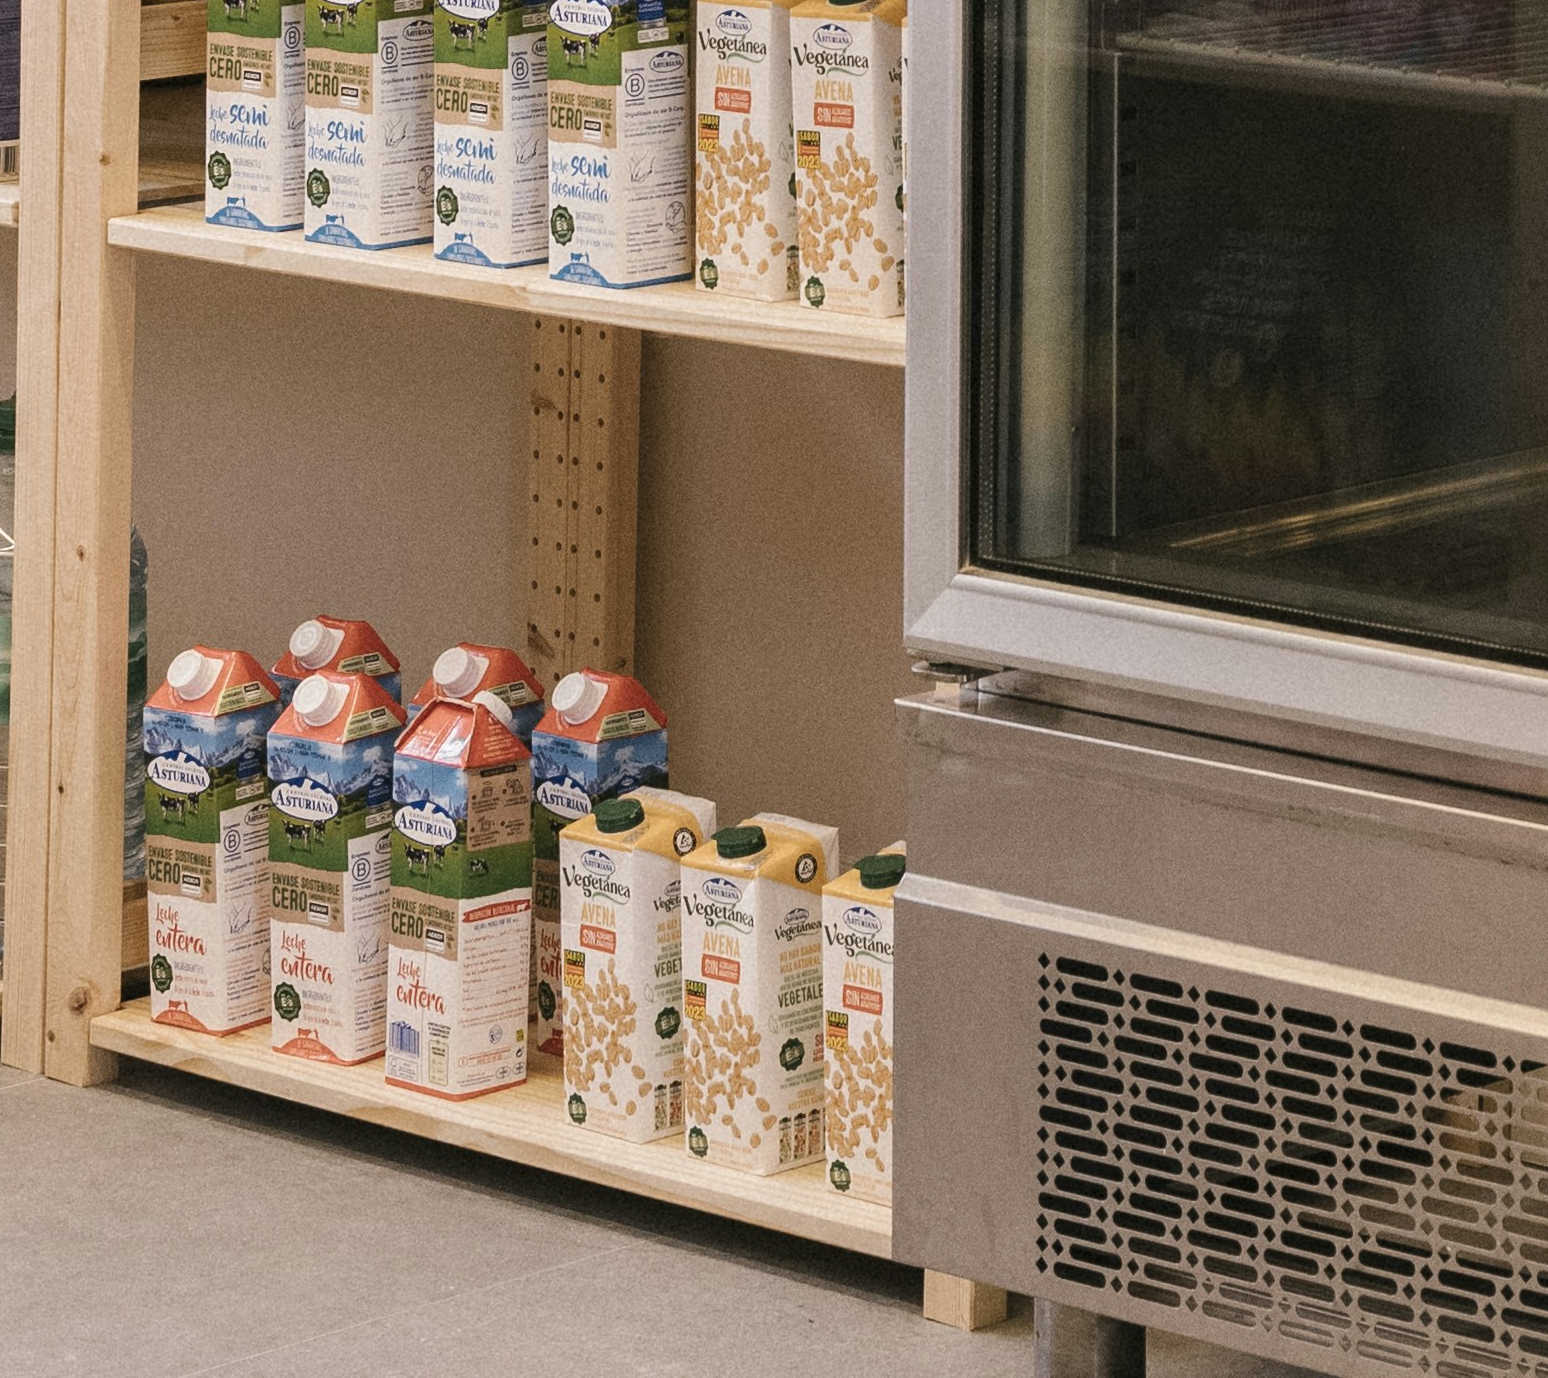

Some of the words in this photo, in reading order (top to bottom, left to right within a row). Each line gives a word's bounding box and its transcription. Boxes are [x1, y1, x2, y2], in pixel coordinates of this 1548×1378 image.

[553, 5, 608, 27] ASTURIANA
[717, 17, 752, 32] ASTURIANA
[698, 28, 767, 60] Vegetánea
[814, 31, 853, 45] ASTURIANA
[210, 43, 235, 58] ENVASE
[236, 46, 273, 63] SOSTENIBLE
[793, 43, 870, 74] Vegetánea
[209, 58, 242, 81] CERO
[307, 58, 332, 74] ENVASE
[333, 62, 370, 76] SOSTENIBLE
[716, 64, 752, 87] AVENA
[307, 74, 339, 97] CERO
[435, 74, 462, 90] ENVASE
[463, 77, 500, 93] SOSTENIBLE
[814, 79, 853, 102] AVENA
[435, 88, 468, 113] CERO
[551, 91, 575, 106] ENVASE
[577, 94, 613, 111] SOSTENIBLE
[717, 91, 731, 108] SIN
[229, 104, 270, 127] semi
[551, 105, 583, 130] CERO
[817, 106, 832, 123] SIN
[209, 124, 270, 150] desnatada
[327, 120, 367, 144] semi
[308, 143, 365, 167] desnatada
[455, 136, 498, 161] semi
[698, 138, 718, 152] 2023
[436, 157, 495, 184] desnatada
[570, 155, 611, 179] semi
[797, 154, 821, 169] 2023
[552, 176, 610, 203] desnatada
[151, 764, 207, 788] ASTURIANA
[274, 788, 334, 816] ASTURIANA
[539, 788, 589, 815] ASTURIANA
[397, 810, 453, 841] ASTURIANA
[148, 844, 174, 860] ENVASE
[174, 847, 213, 868] SOSTENIBLE
[583, 857, 615, 873] ASTURIANA
[148, 859, 181, 885] CERO
[562, 864, 631, 898] Vegetánea
[272, 872, 299, 887] ENVASE
[301, 876, 340, 897] SOSTENIBLE
[705, 885, 741, 901] ASTURIANA
[272, 884, 308, 913] CERO
[391, 896, 417, 914] ENVASE
[418, 900, 456, 924] SOSTENIBLE
[682, 892, 754, 928] Vegetánea
[155, 901, 180, 925] Leche
[580, 901, 617, 928] AVENA
[845, 914, 880, 930] ASTURIANA
[391, 911, 424, 940] CERO
[582, 927, 596, 947] SIN
[774, 919, 822, 942] Vegetánea
[156, 923, 207, 956] entera
[280, 929, 307, 951] Leche
[703, 930, 741, 959] AVENA
[824, 921, 894, 958] Vegetáne
[281, 951, 335, 986] entera
[397, 956, 421, 979] Leche
[654, 959, 683, 978] VEGET
[704, 957, 719, 976] SIN
[843, 960, 883, 989] AVENA
[564, 974, 585, 989] 2023
[396, 979, 447, 1015] entera
[777, 983, 823, 1009] VEGETALE
[845, 988, 860, 1007] SIN
[684, 1004, 707, 1020] 2023
[825, 1034, 848, 1053] 2023
